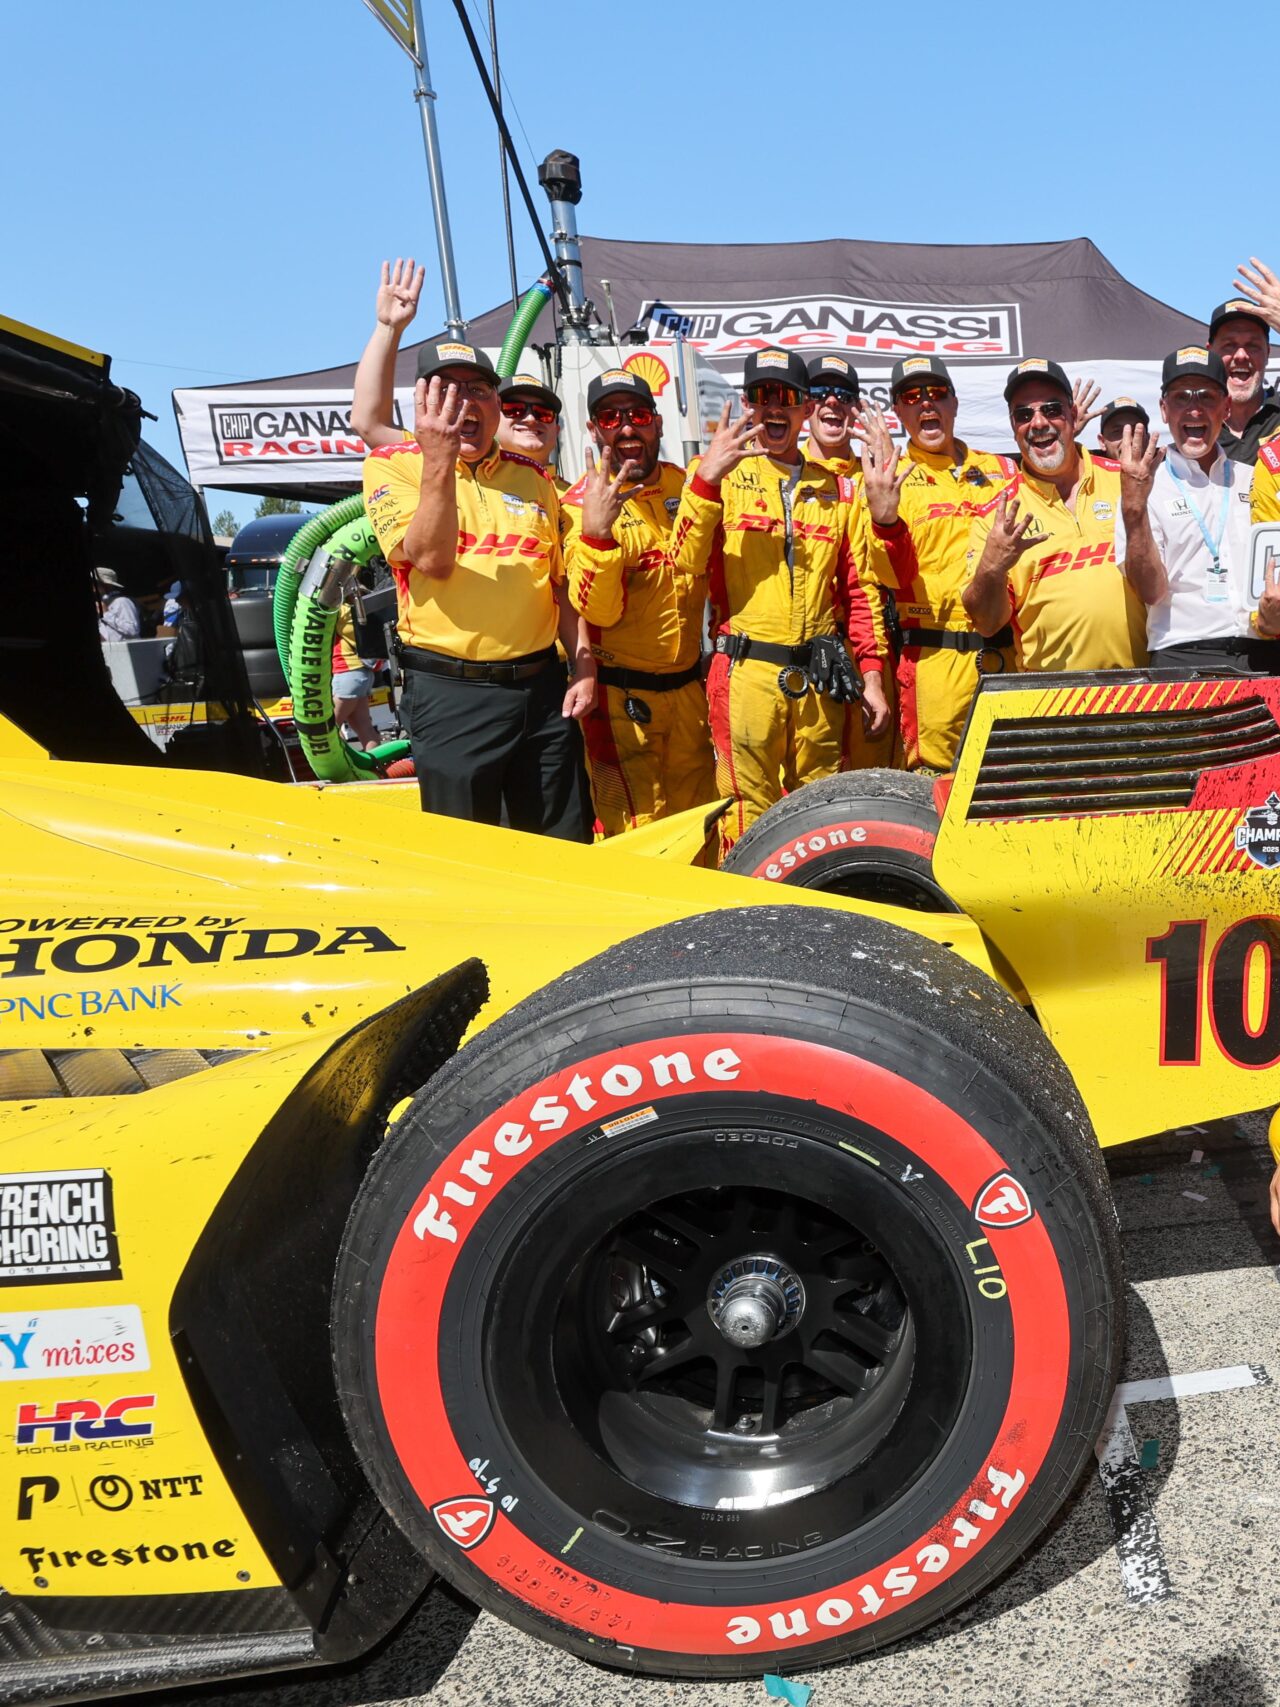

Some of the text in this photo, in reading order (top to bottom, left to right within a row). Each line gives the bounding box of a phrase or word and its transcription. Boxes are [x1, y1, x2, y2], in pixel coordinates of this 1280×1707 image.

[722, 305, 1002, 340] GANASSI
[222, 410, 353, 439] CHIP GANA
[223, 439, 366, 457] RACIN
[1037, 541, 1116, 579] DH
[301, 672, 324, 719] RACE
[307, 733, 331, 757] UEL
[757, 826, 868, 880] estone
[0, 915, 247, 933] OWERED by
[0, 926, 407, 978] HONDA
[0, 983, 184, 1024] PNC BANK
[413, 1048, 742, 1244] Firestone
[714, 1132, 800, 1149] FORGED
[0, 1180, 104, 1231] RENCH
[7, 1262, 106, 1277] OMPANY
[41, 1337, 137, 1368] mixes
[16, 1395, 156, 1444] HRC
[16, 1437, 156, 1455] Honda RACING
[140, 1474, 204, 1501] NTT
[19, 1537, 239, 1575] Firestone
[699, 1530, 823, 1559] RACING
[725, 1465, 1026, 1646] Firestone
